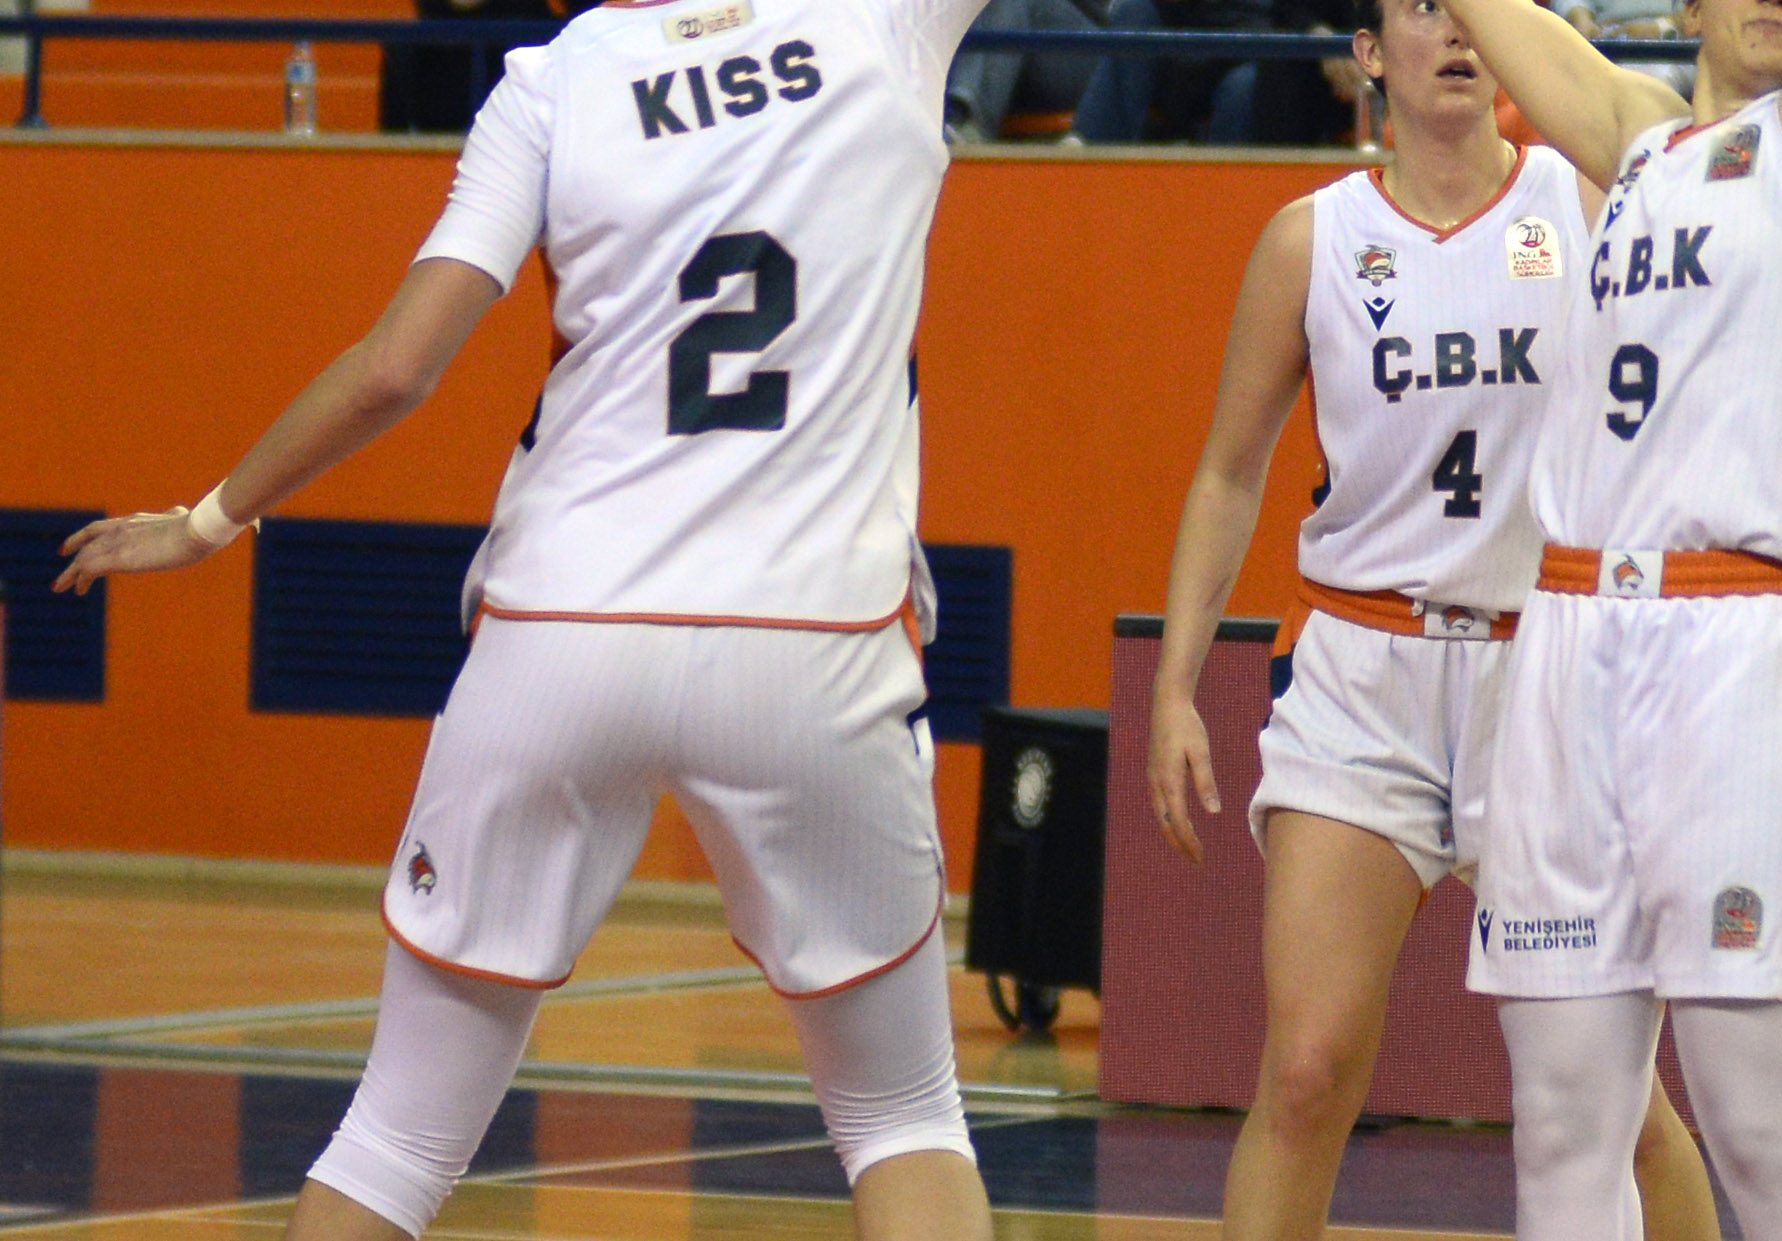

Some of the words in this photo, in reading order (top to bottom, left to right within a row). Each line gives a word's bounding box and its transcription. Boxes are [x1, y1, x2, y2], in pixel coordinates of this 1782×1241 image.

[631, 40, 822, 140] KISS
[1591, 226, 1713, 311] Ç.B.K
[667, 230, 797, 435] 2
[1373, 328, 1542, 403] Ç.B.K
[1606, 343, 1659, 441] 9
[1432, 429, 1483, 520] 4
[1503, 915, 1595, 936] YENİŞEHİR
[1503, 933, 1597, 951] BELEDİYESİ
